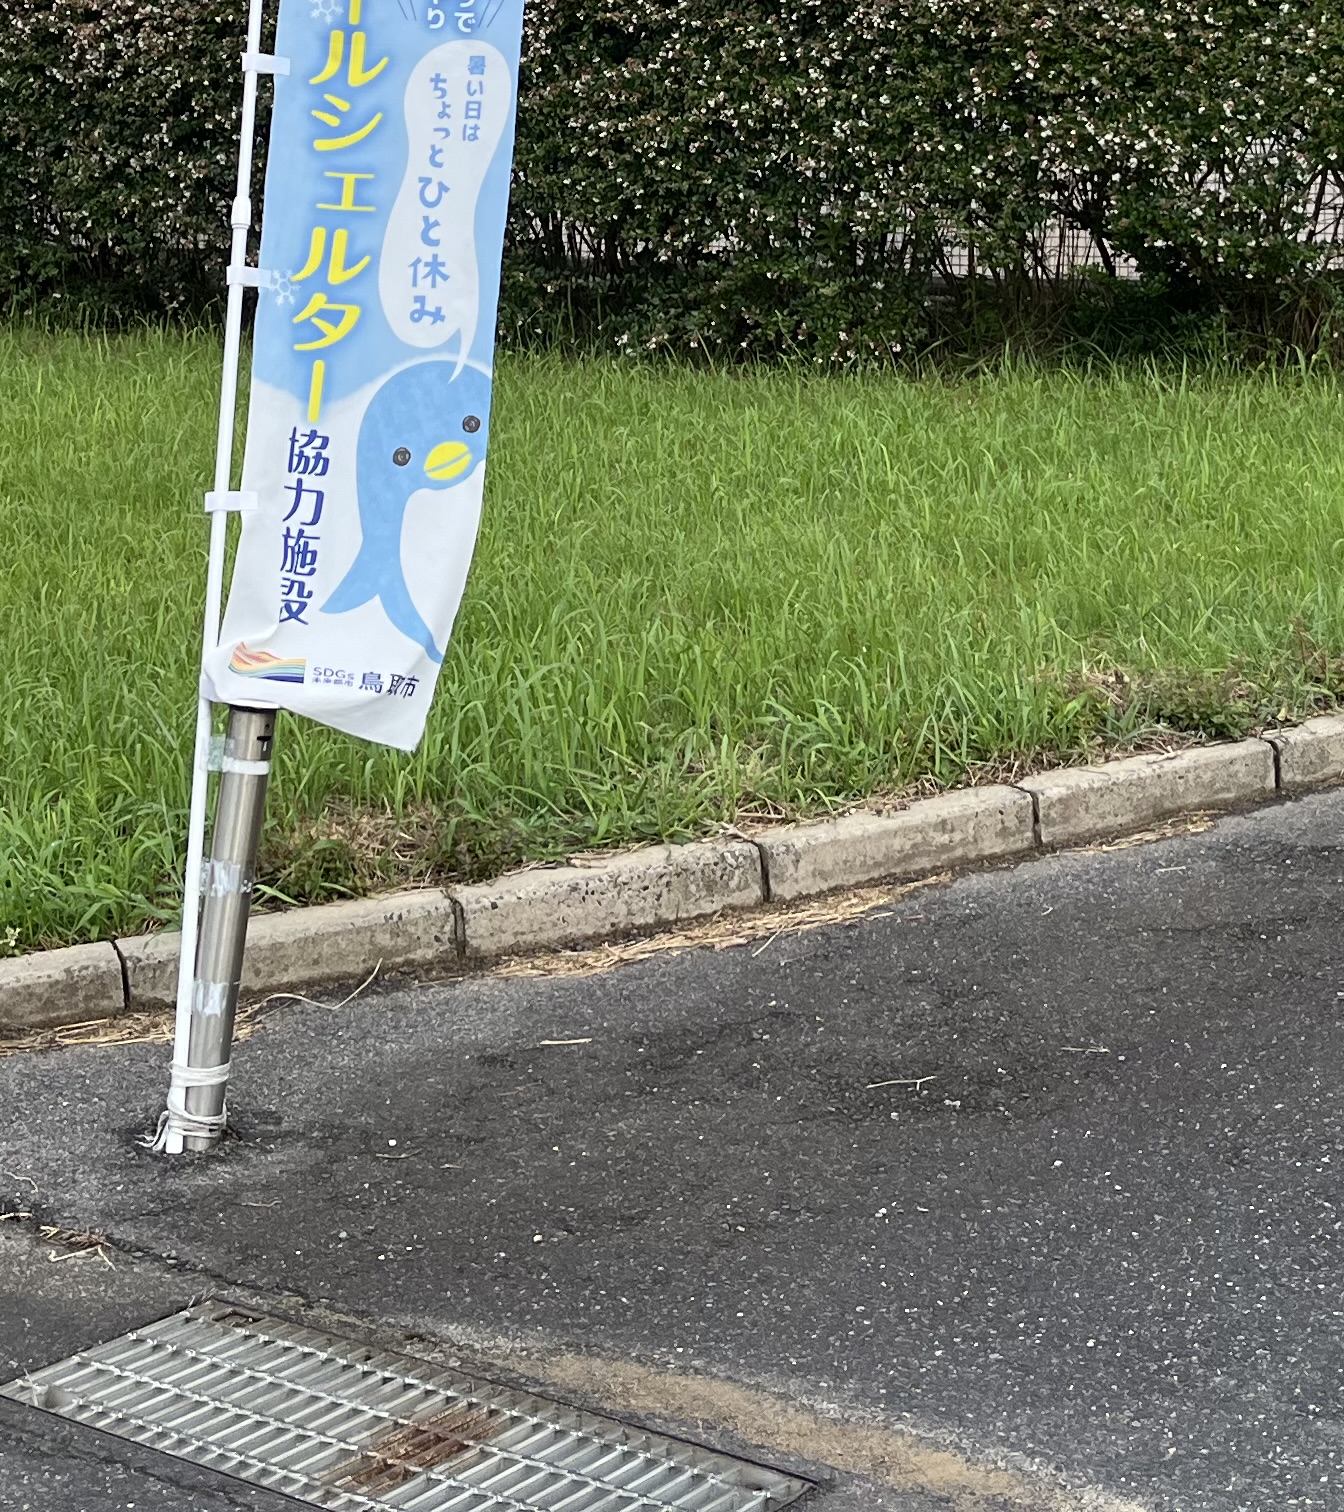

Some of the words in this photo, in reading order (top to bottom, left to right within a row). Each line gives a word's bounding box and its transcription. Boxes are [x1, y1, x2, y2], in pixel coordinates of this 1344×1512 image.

[461, 55, 487, 142] 暑い日は
[408, 74, 452, 326] ちょっとひと休み
[279, 426, 330, 626] 協力施設
[313, 666, 355, 681] SDGs
